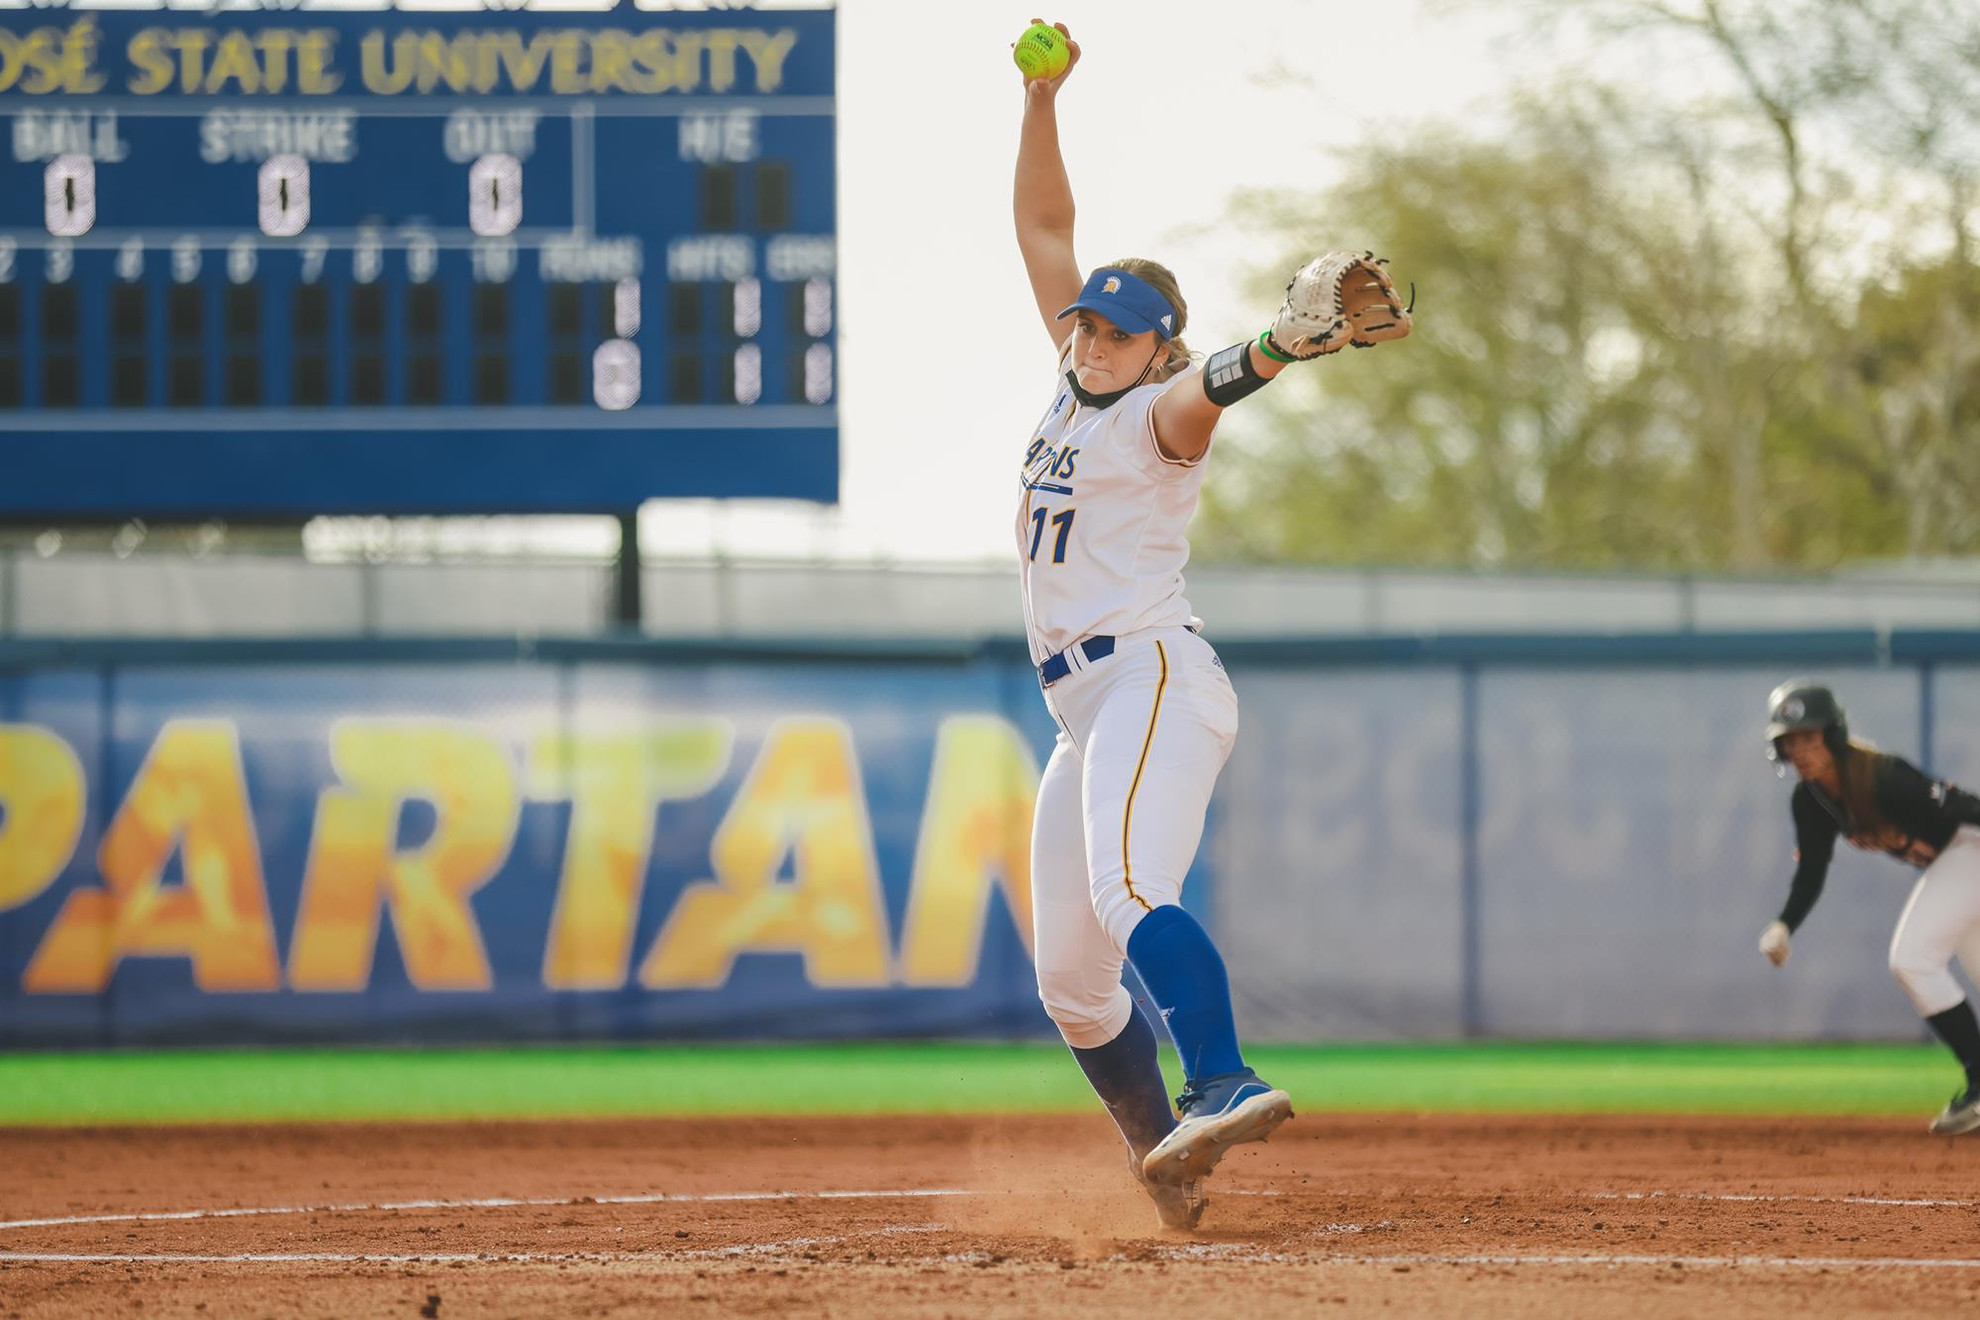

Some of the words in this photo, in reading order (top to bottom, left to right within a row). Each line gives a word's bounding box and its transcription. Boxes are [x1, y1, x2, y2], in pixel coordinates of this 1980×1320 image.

[126, 27, 344, 94] STATE
[361, 27, 796, 95] UNIVERSITY
[13, 108, 130, 163] BALL
[201, 107, 357, 163] STRIKE
[444, 108, 540, 163] OUT
[44, 154, 96, 236] 0
[258, 154, 311, 237] 0
[469, 154, 523, 237] 0
[45, 236, 74, 284] 3
[115, 236, 144, 283] 4
[171, 236, 201, 284] 5
[227, 236, 258, 284] 6
[299, 236, 329, 284] 7
[352, 236, 383, 284] 8
[406, 236, 438, 284] 9
[472, 236, 517, 284] 10
[666, 236, 756, 283] HITS
[1030, 506, 1076, 564] 11
